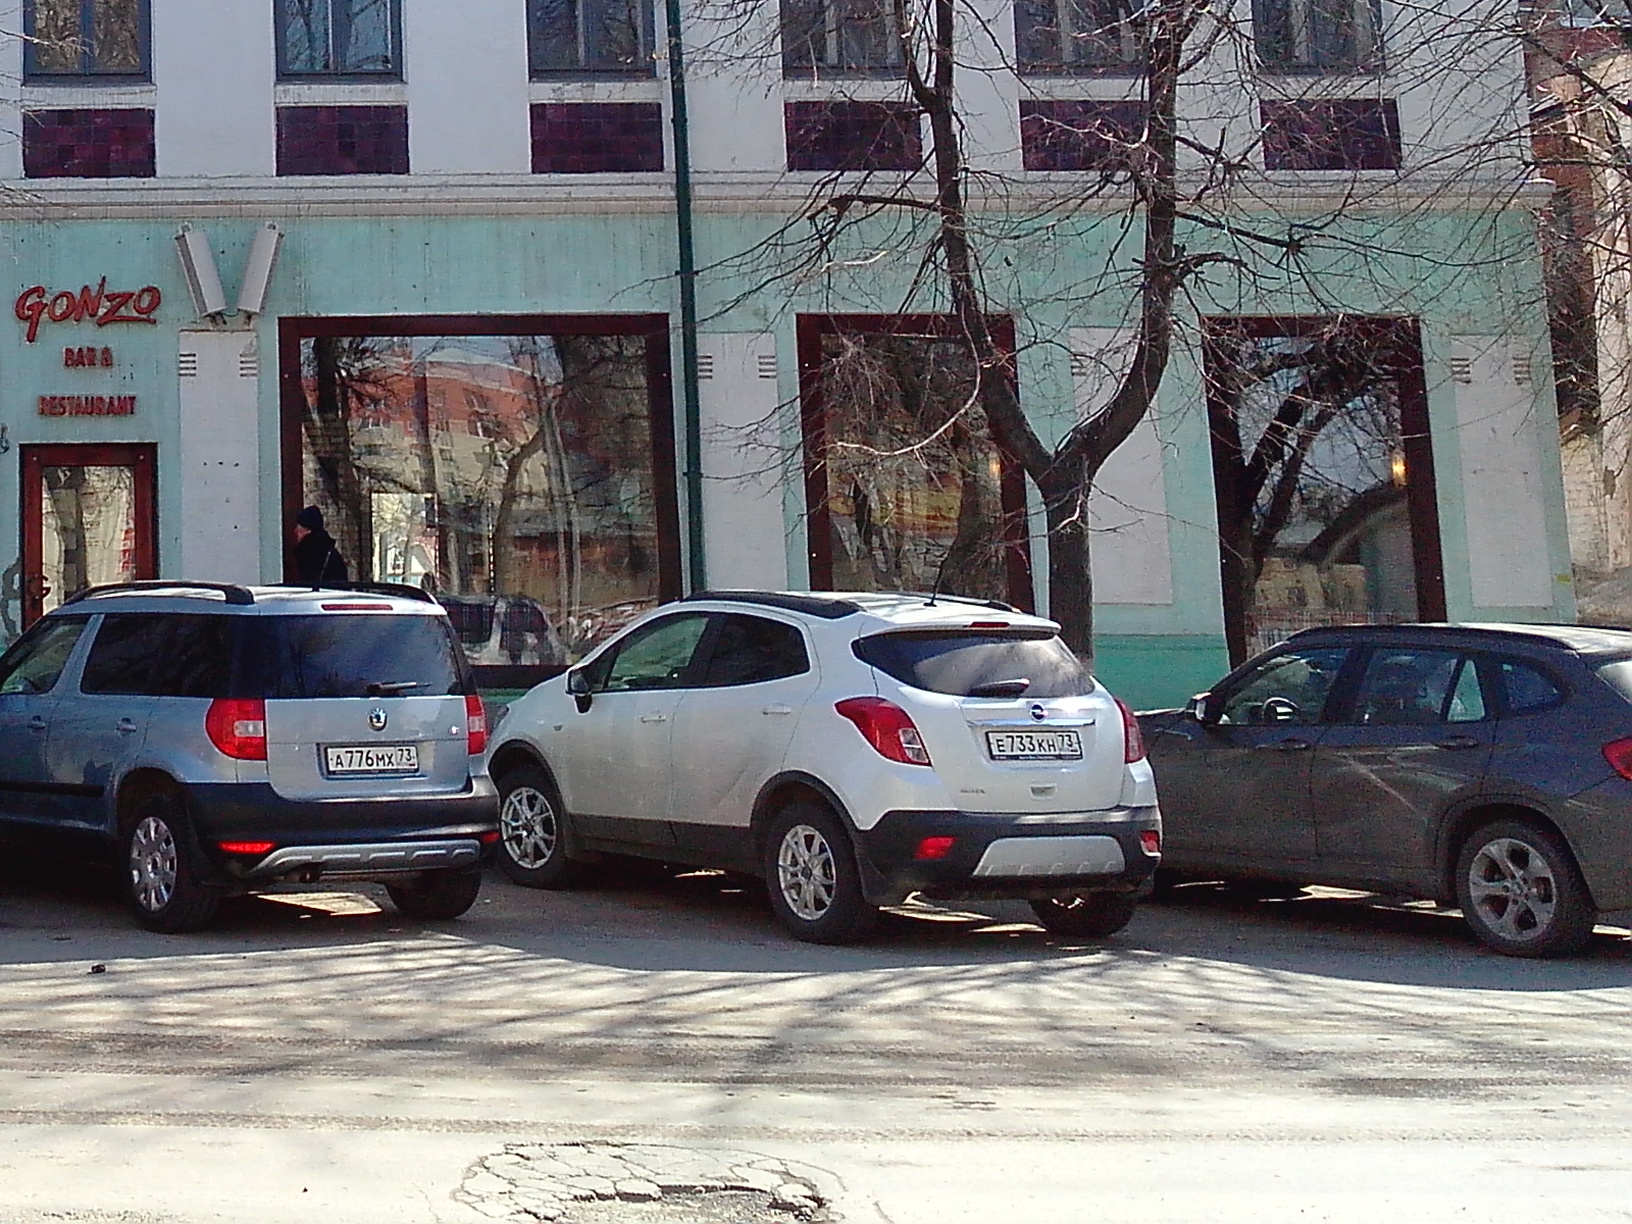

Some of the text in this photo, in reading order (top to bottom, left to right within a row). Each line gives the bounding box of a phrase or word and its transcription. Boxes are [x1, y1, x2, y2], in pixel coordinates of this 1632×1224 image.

[14, 275, 161, 343] GONZO
[64, 347, 97, 367] BAR
[38, 395, 137, 416] RESTAURANT
